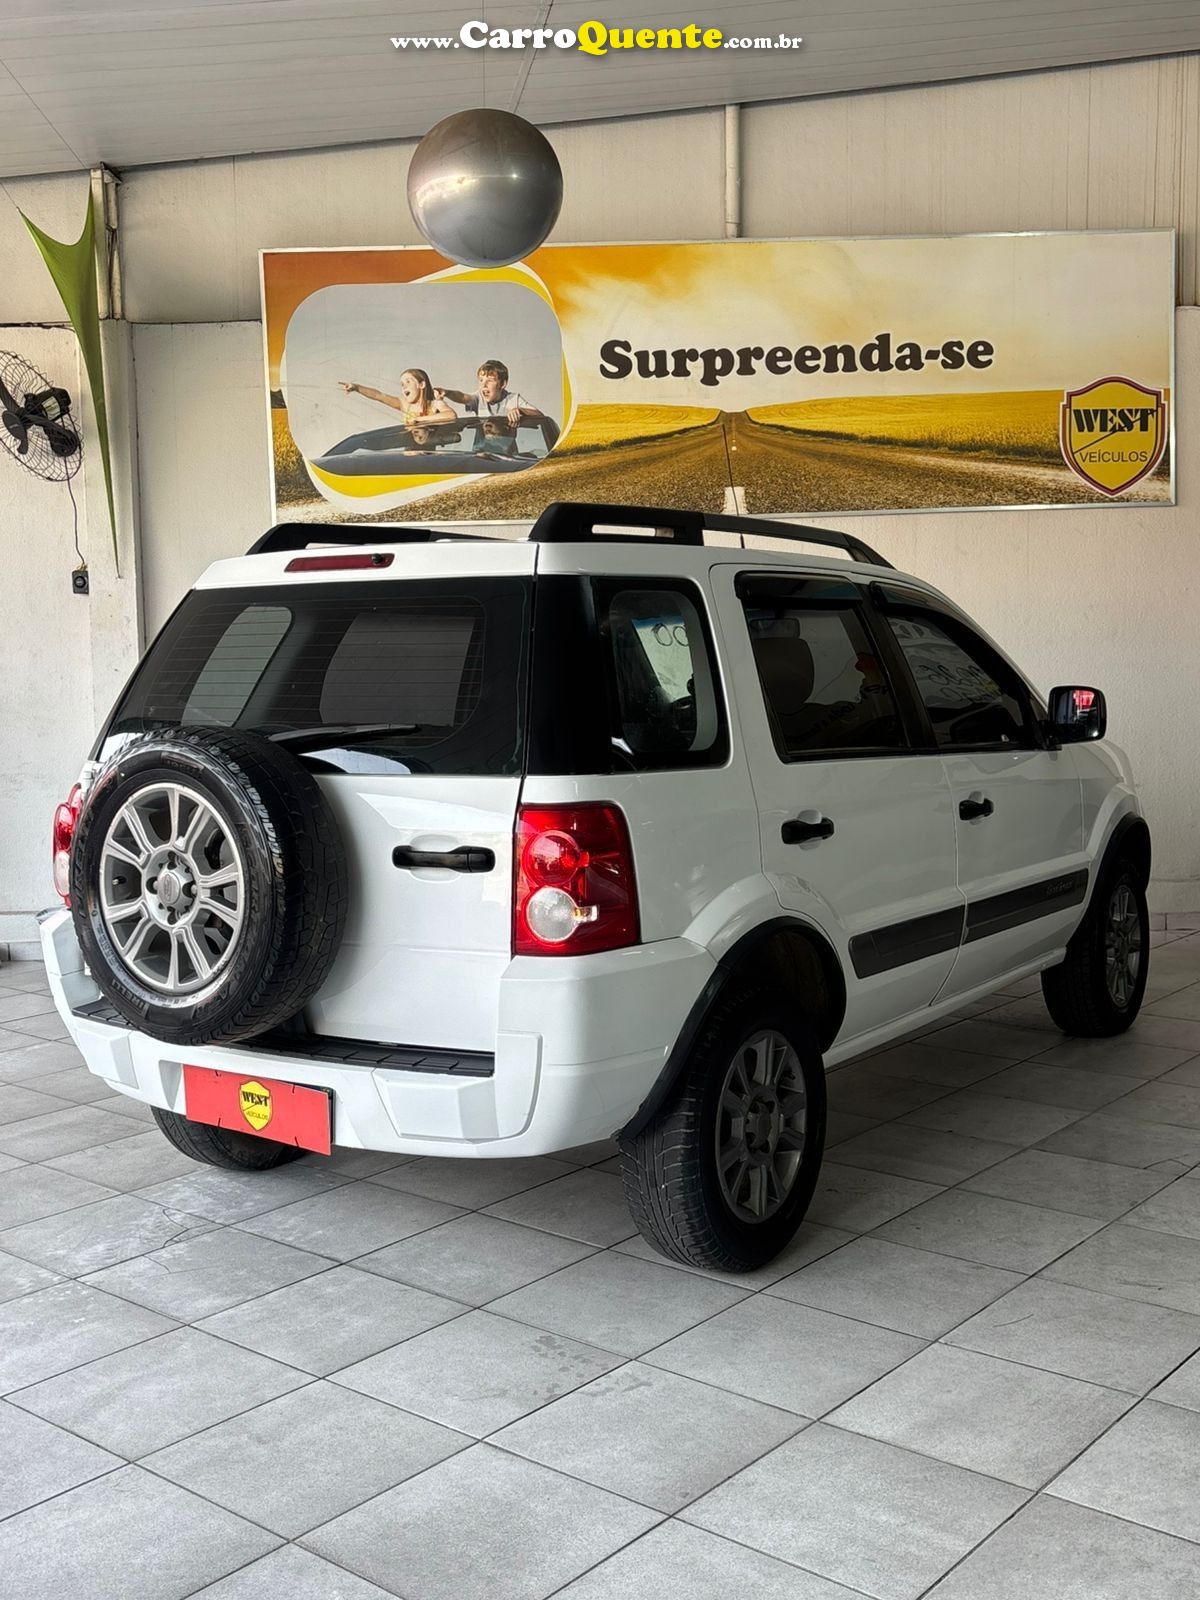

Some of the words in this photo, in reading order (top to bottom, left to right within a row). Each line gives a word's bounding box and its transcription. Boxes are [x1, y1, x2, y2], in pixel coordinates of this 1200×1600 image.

[600, 333, 994, 386] Surpreenda-se
[1073, 408, 1156, 433] WEST
[1079, 449, 1148, 463] VEÍCULOS
[242, 1092, 270, 1107] WEST
